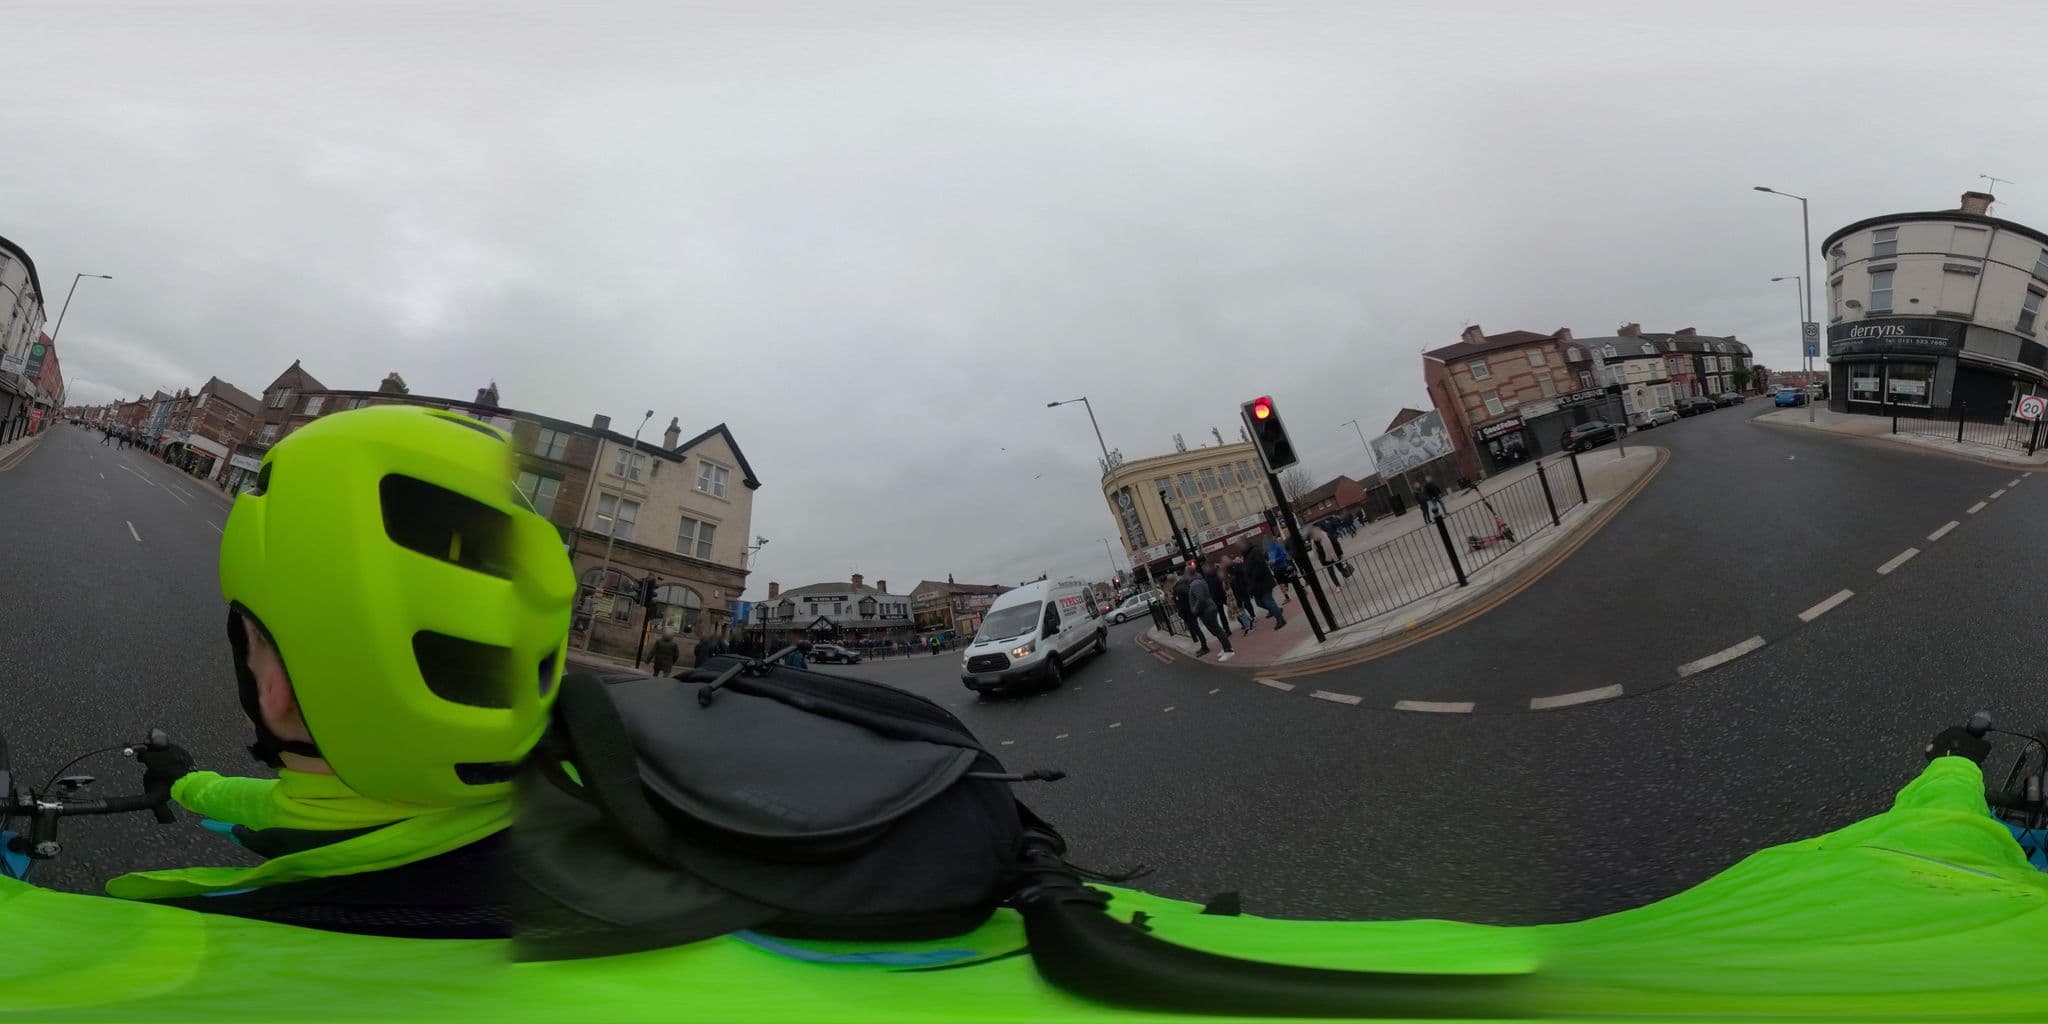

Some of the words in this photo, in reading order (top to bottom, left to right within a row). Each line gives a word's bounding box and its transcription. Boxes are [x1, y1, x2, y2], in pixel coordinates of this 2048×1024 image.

[1850, 324, 1905, 339] derryns
[1572, 389, 1605, 402] CUISINE
[2023, 403, 2039, 414] 20
